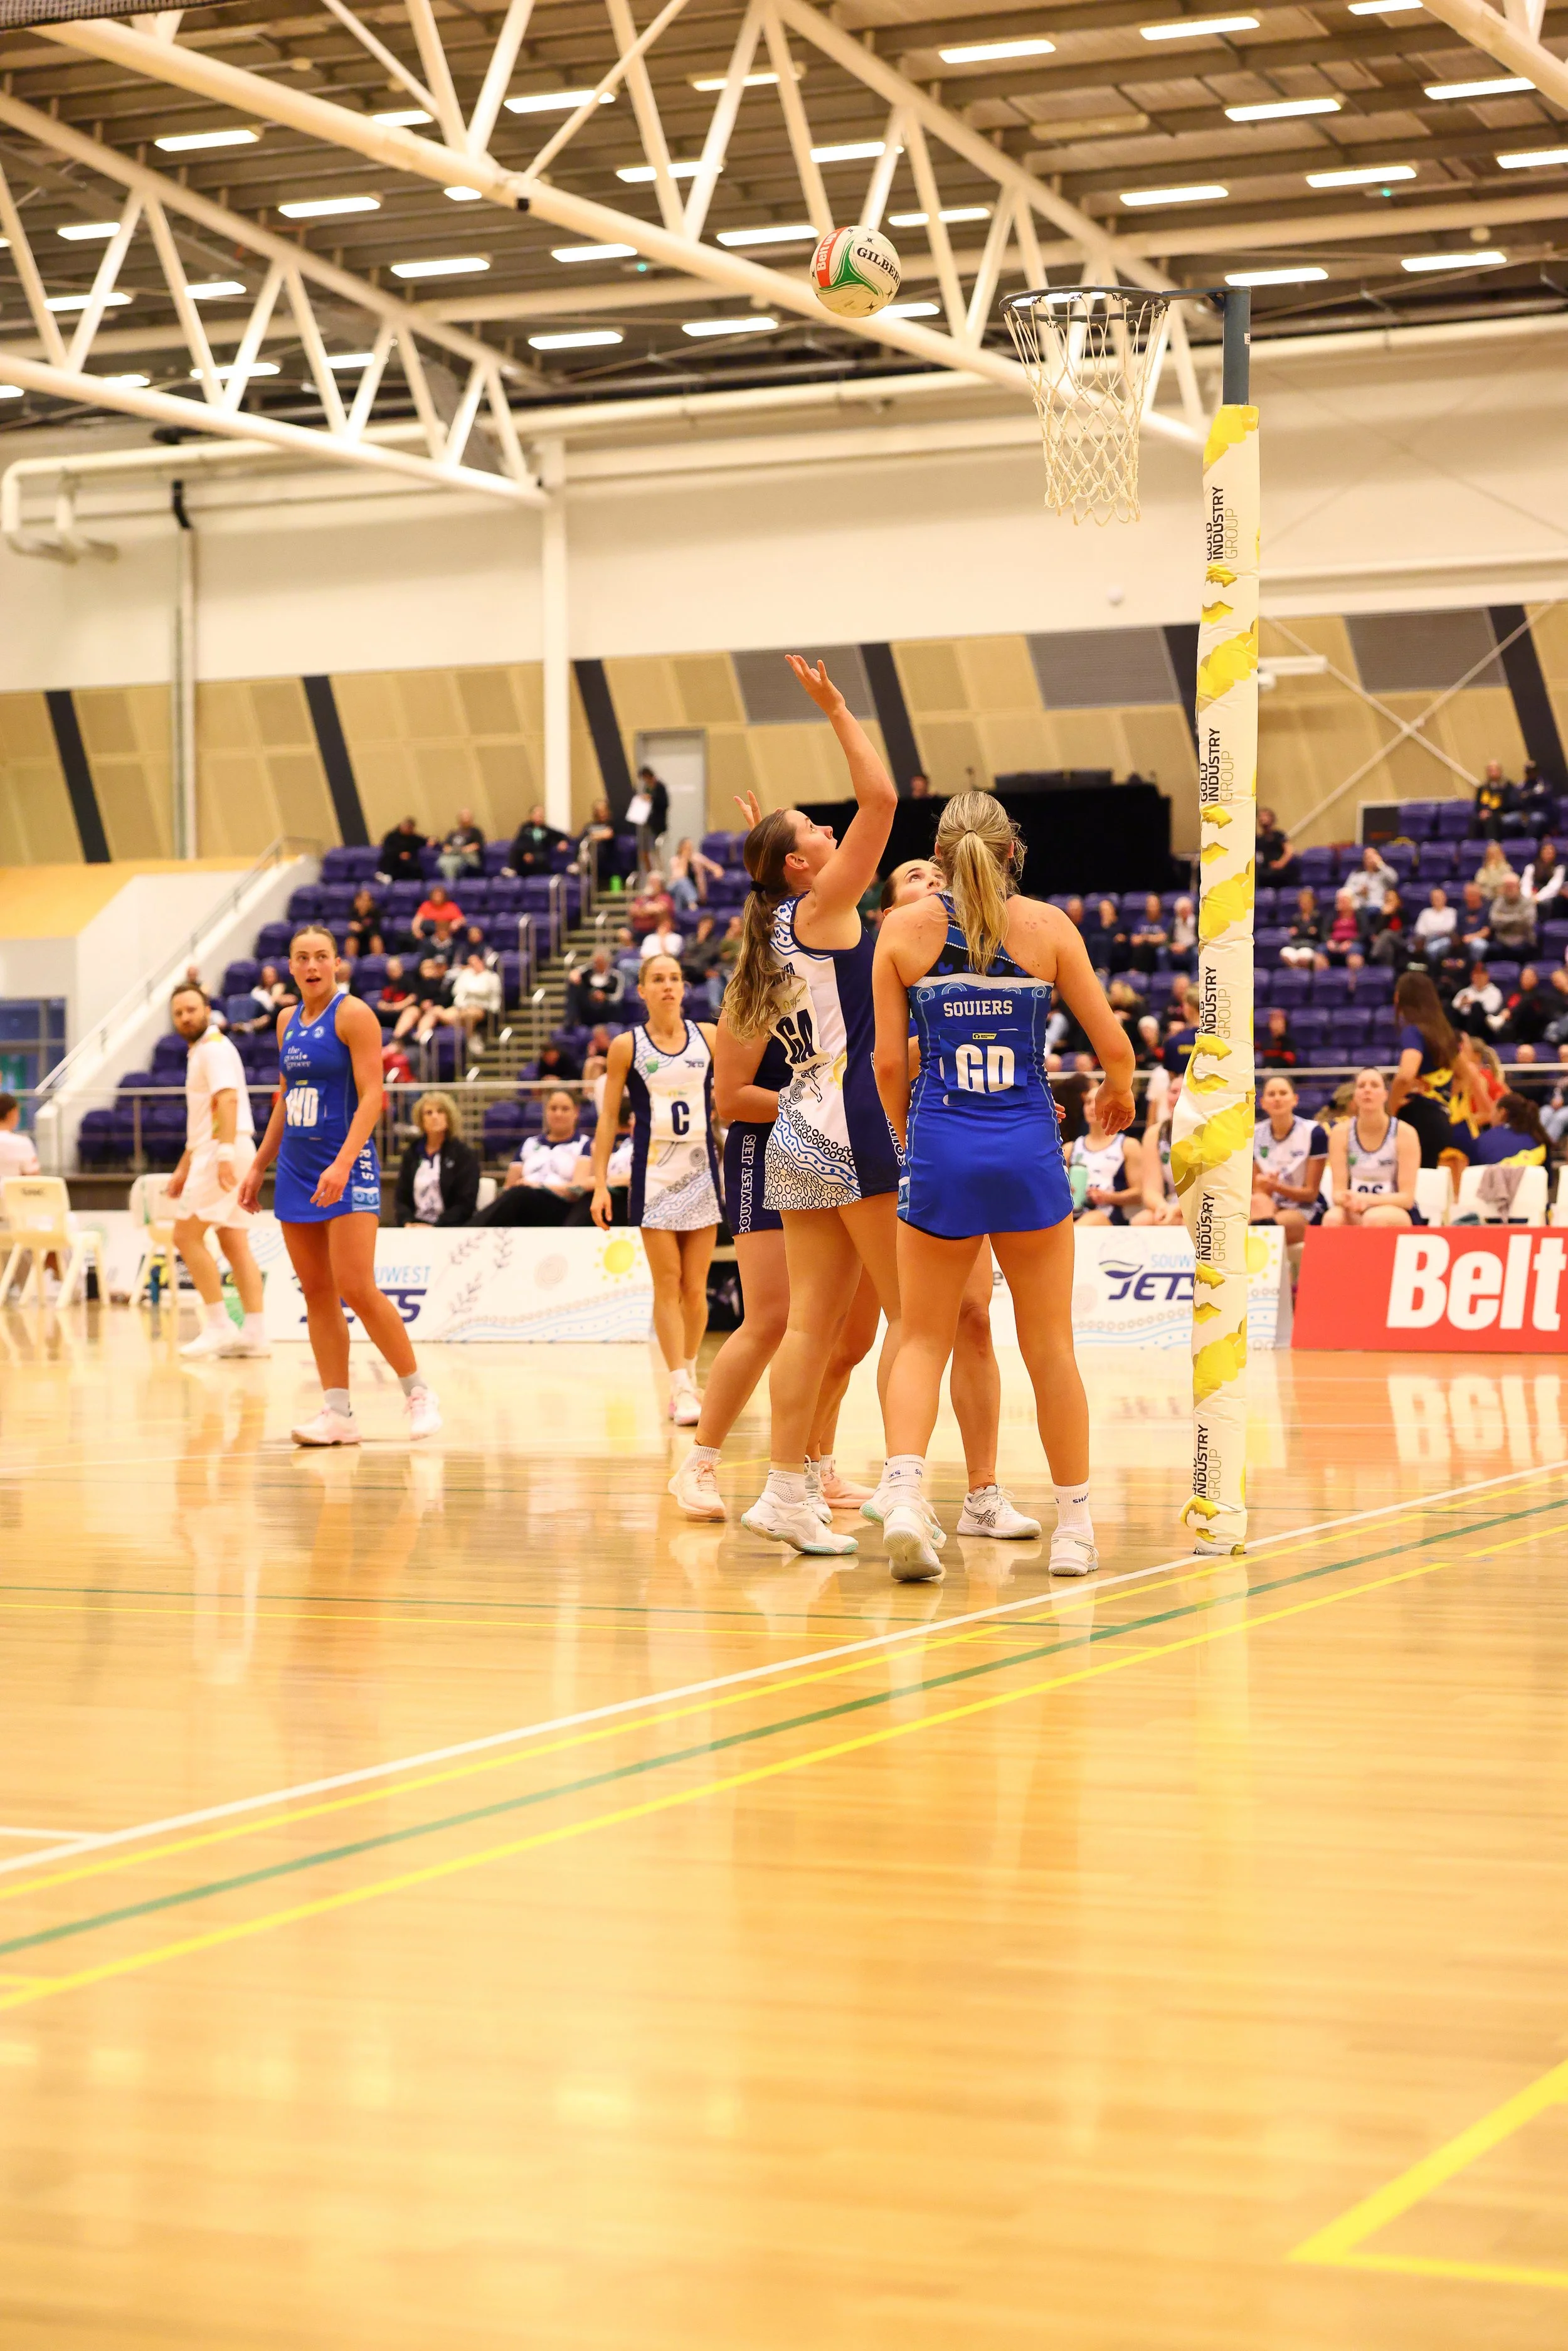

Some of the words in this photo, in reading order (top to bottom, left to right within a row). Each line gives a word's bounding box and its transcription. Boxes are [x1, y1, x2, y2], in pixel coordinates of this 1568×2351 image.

[817, 245, 830, 271] Belt
[1212, 486, 1224, 560] INDUSTRY
[1225, 508, 1238, 559] GROUP
[1200, 762, 1208, 802] GOLD
[1208, 728, 1220, 802] INDUSTRY
[1220, 751, 1234, 802] GROUP
[943, 1000, 1013, 1017] SQUIERS
[1205, 966, 1217, 1034] NDUSTRY
[776, 1009, 818, 1064] GA
[955, 1044, 1015, 1093] GD
[285, 1087, 319, 1127] WD
[671, 1100, 690, 1135] C
[741, 1134, 757, 1165] JETS
[739, 1167, 753, 1234] SOUWEST
[1151, 1253, 1195, 1269] SOUW
[1212, 1221, 1226, 1261] GROU
[374, 1266, 431, 1283] UWEST
[1386, 1234, 1567, 1331] Belt
[1197, 1424, 1209, 1499] INDUSTRY
[1207, 1448, 1222, 1500] GROUP
